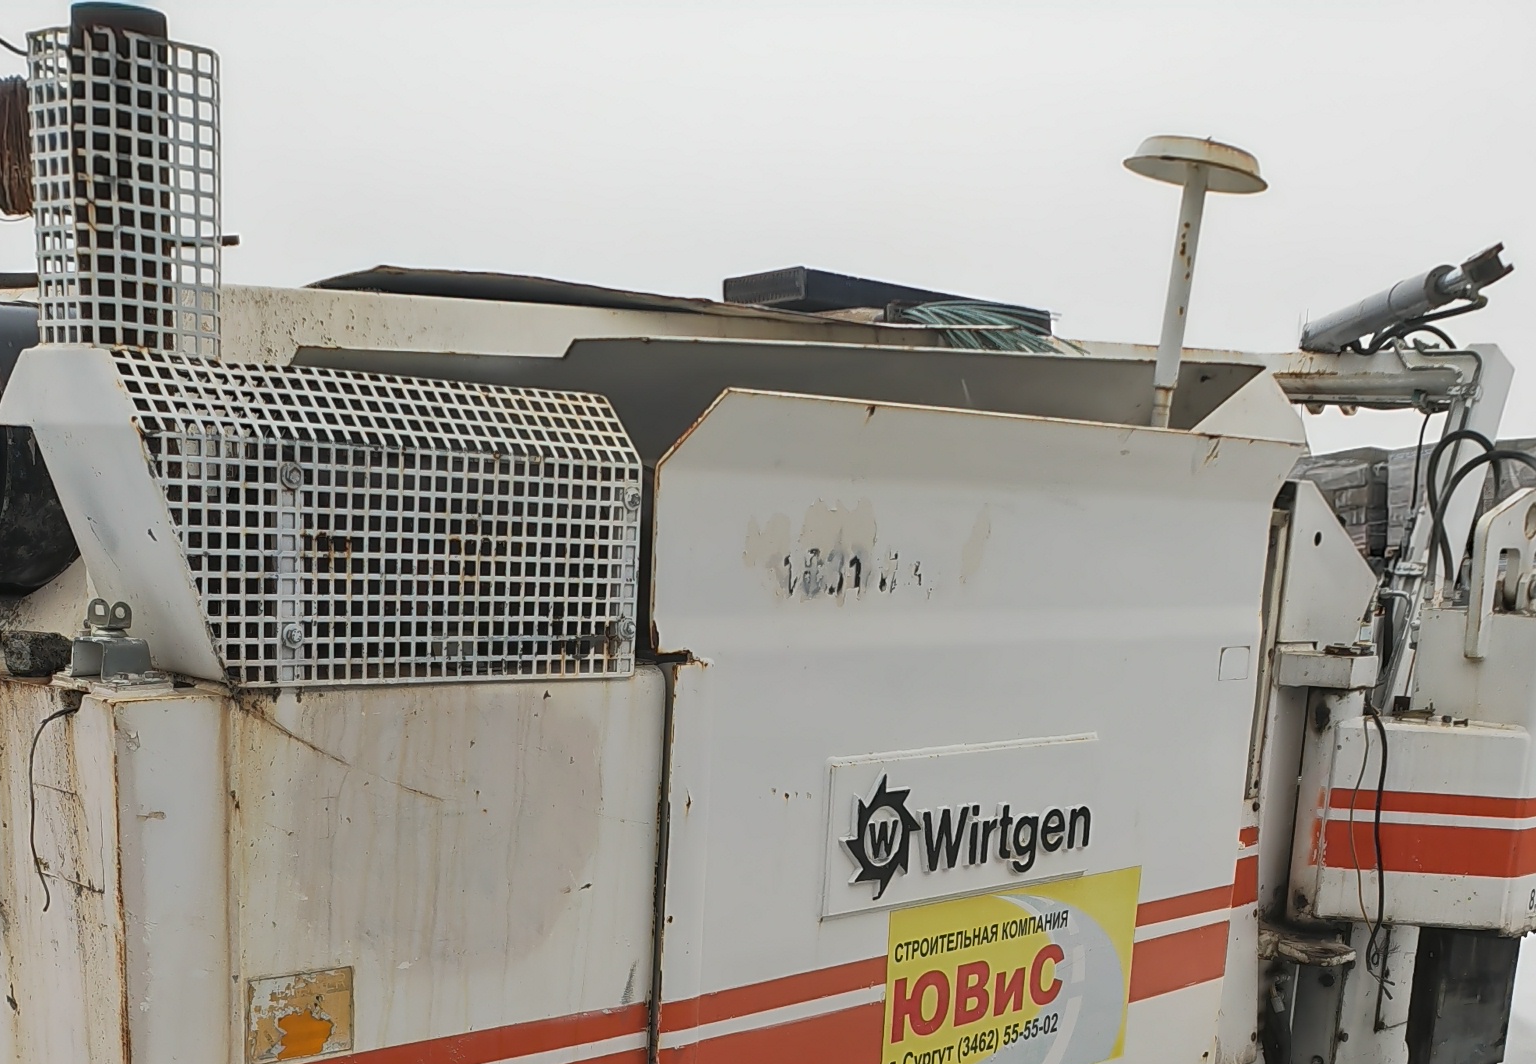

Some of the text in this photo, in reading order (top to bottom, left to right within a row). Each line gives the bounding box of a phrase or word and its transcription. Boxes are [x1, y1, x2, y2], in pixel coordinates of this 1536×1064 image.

[868, 803, 1092, 874] W Wirtgen
[894, 909, 1069, 963] СТРОИТЕЛЬНАЯ КОМПАНИЯ
[890, 943, 1065, 1044] ЮВиС
[957, 1027, 1000, 1064] (3462)
[1002, 1012, 1060, 1046] 55-55-02
